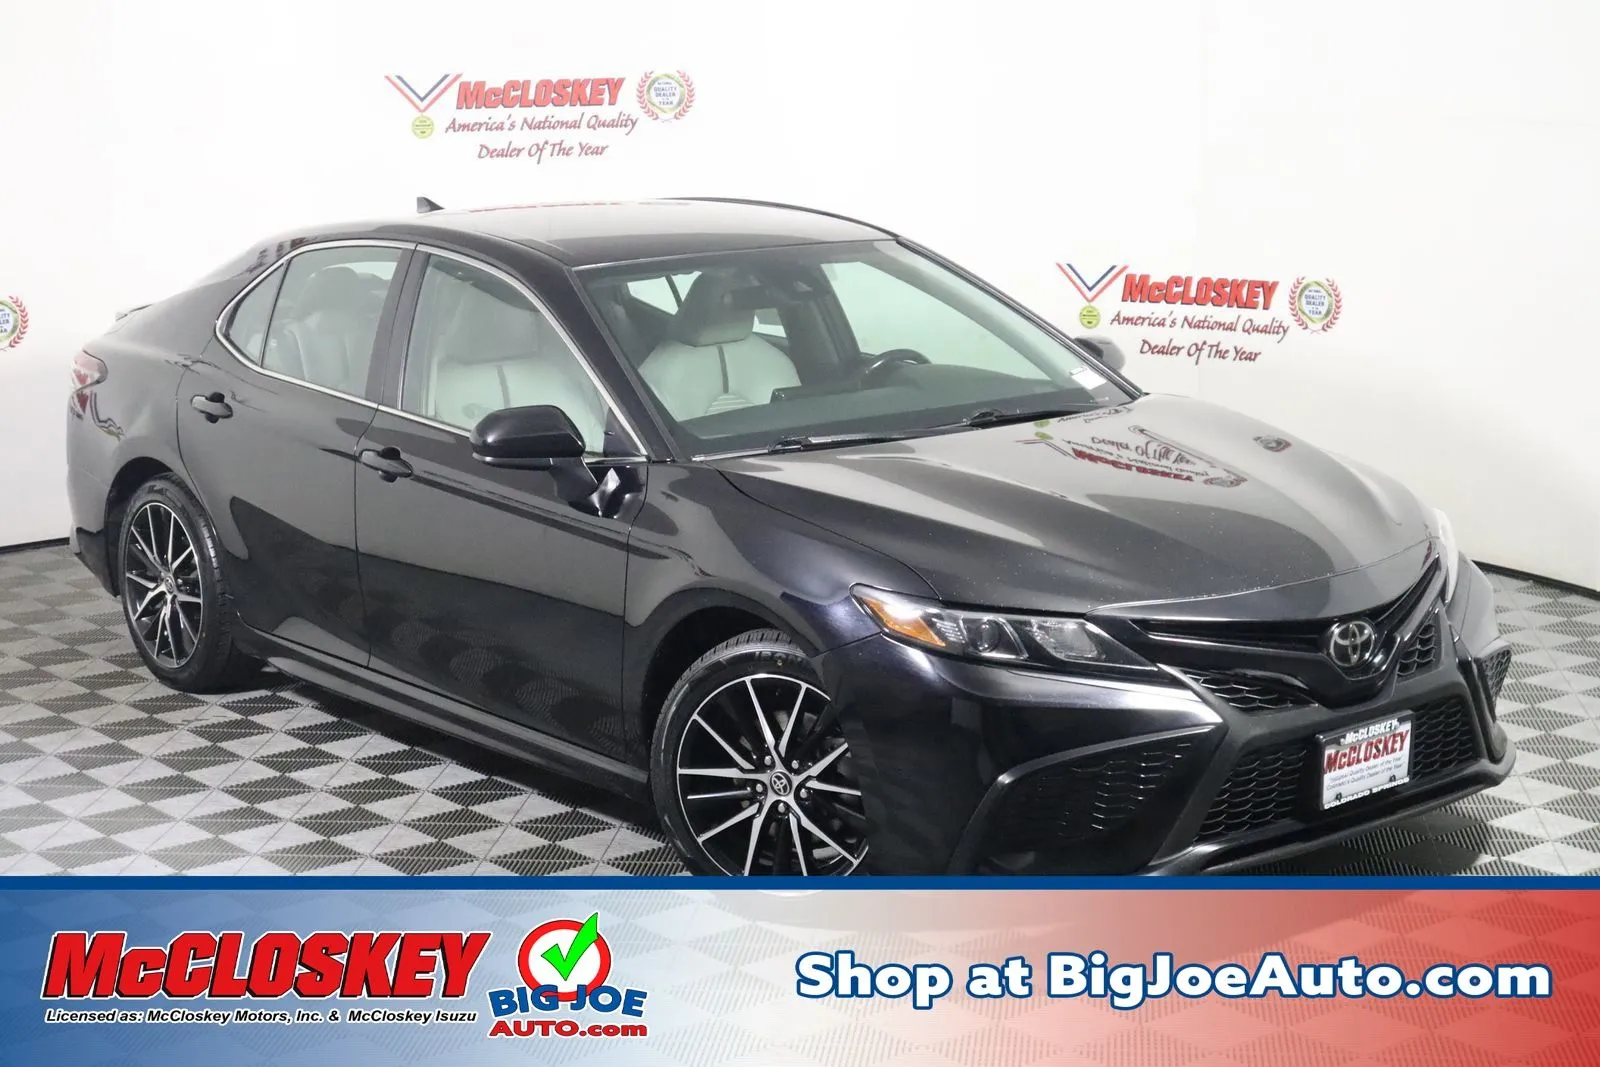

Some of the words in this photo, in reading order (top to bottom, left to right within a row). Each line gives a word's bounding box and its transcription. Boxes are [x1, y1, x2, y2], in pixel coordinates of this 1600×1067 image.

[456, 77, 625, 109] McCLOSKEY
[445, 113, 516, 133] America's
[520, 112, 584, 131] National
[586, 110, 639, 136] Quality
[478, 140, 525, 159] Dealer
[528, 139, 549, 165] Of
[550, 139, 574, 157] The
[578, 141, 609, 157] Year
[1121, 273, 1279, 310] McCLOSKEY
[1109, 310, 1177, 328] America's
[1181, 314, 1241, 332] National
[1241, 317, 1289, 344] Quality
[1139, 338, 1184, 356] Dealer
[1187, 340, 1207, 365] Of
[1207, 341, 1230, 359] The
[1232, 345, 1262, 362] Year
[1323, 729, 1409, 774] McCLOSKEY
[1324, 789, 1370, 810] COLORADO
